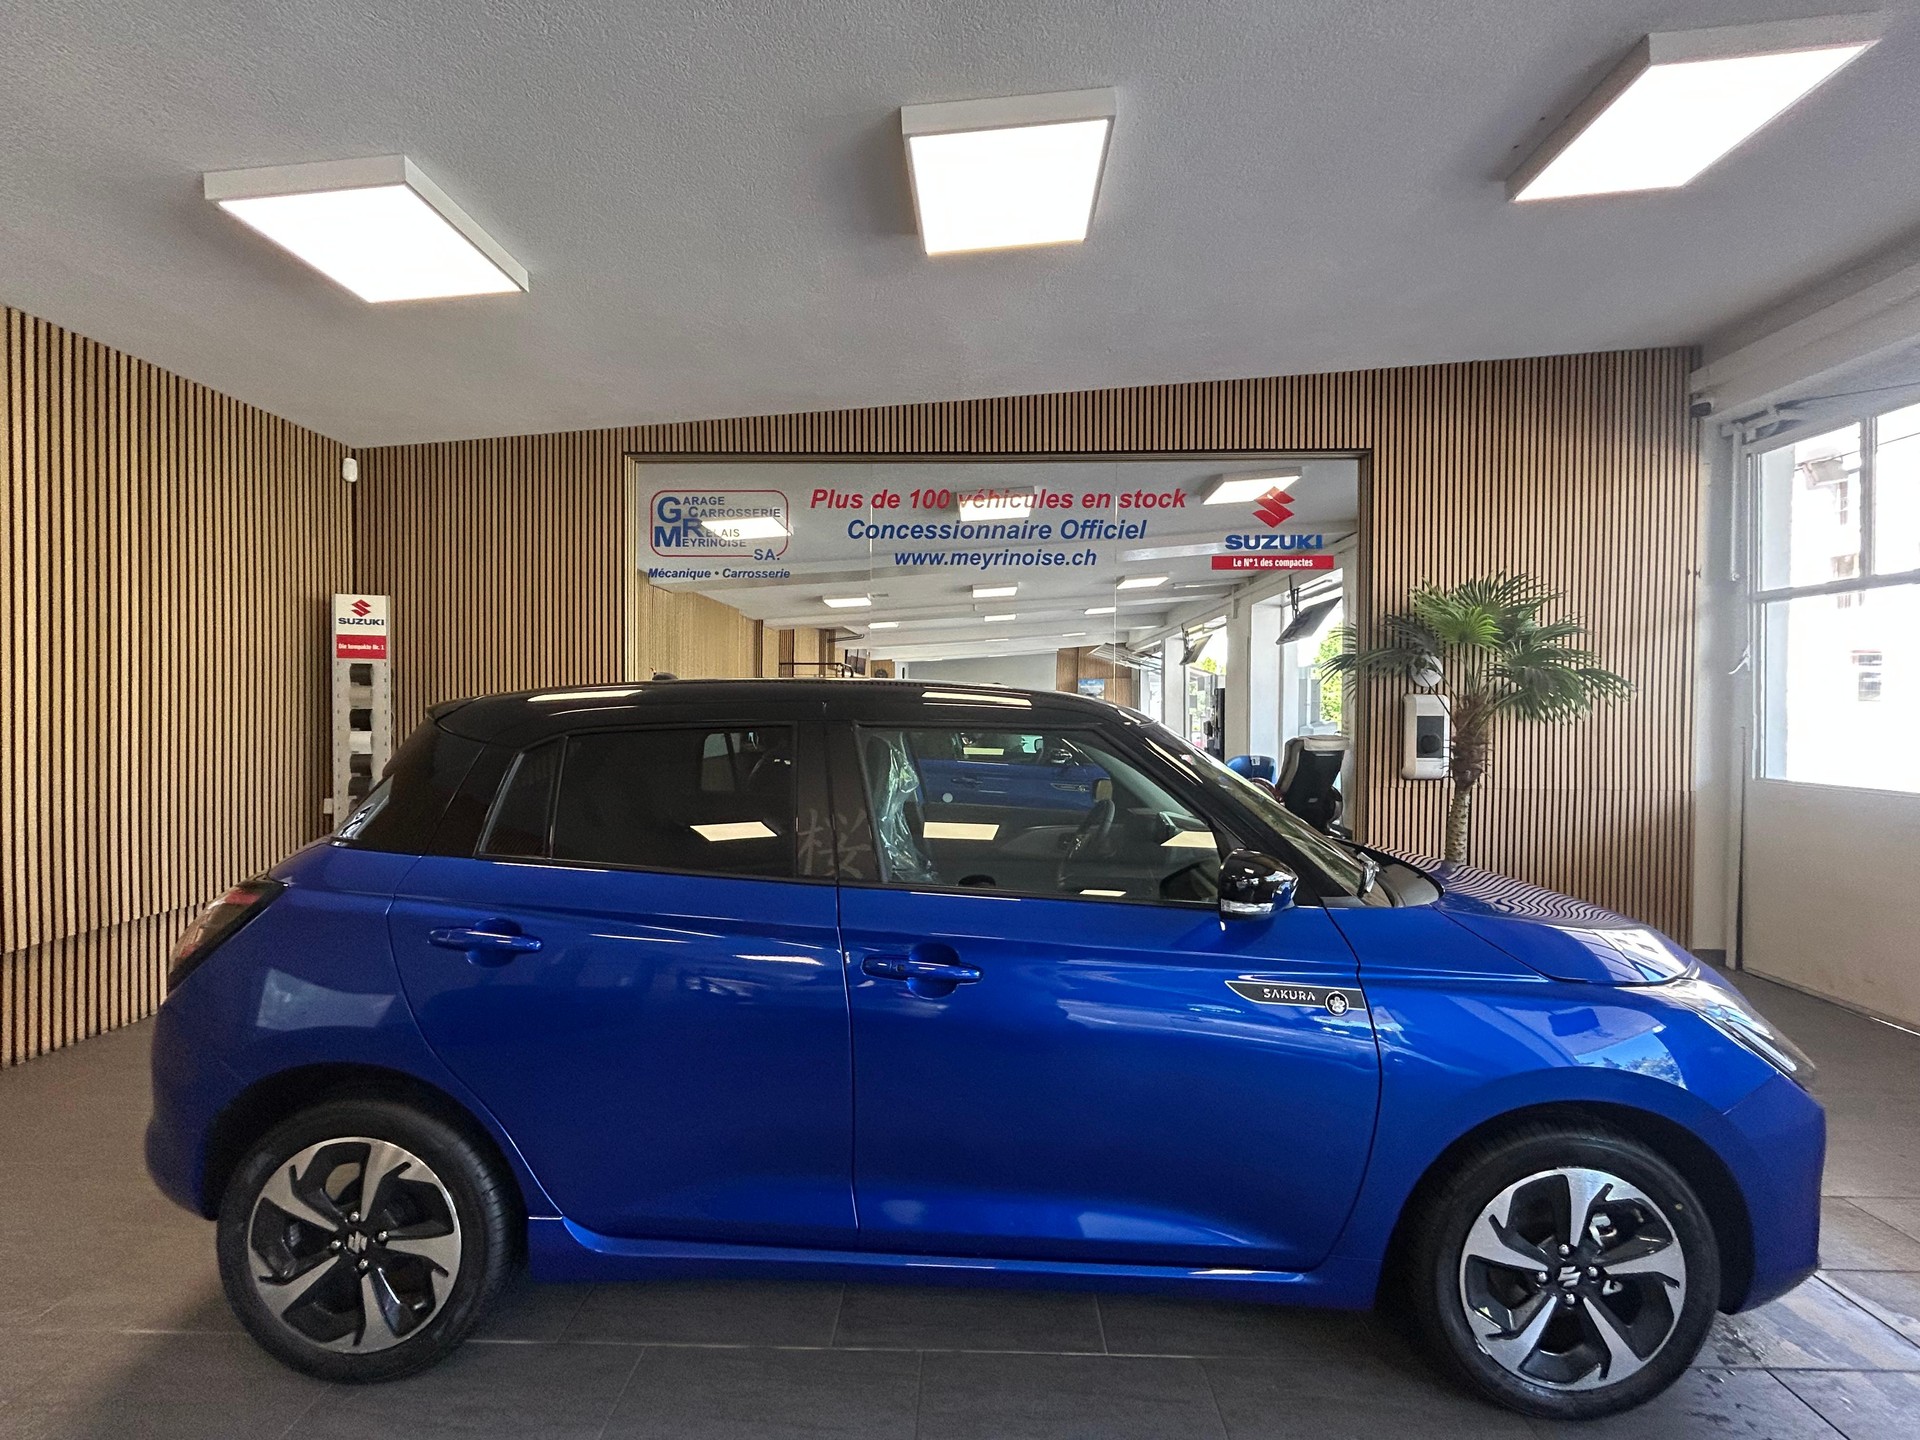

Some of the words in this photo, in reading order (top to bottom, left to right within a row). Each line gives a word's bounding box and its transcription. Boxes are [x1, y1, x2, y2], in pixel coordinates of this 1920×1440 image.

[810, 489, 864, 509] Plus
[871, 489, 901, 509] de
[909, 489, 950, 509] 100
[958, 489, 1073, 509] véhicules
[1081, 493, 1111, 509] en
[1118, 488, 1190, 509] stock
[847, 519, 1052, 540] Concessionnaire
[1060, 519, 1148, 540] Officiel
[1225, 534, 1323, 550] SUZUKI
[894, 548, 1098, 570] www.meyrinoise.ch
[1233, 558, 1242, 567] Le
[1260, 558, 1273, 567] des
[1274, 558, 1313, 569] compactes
[648, 568, 711, 581] Mécanique
[722, 568, 791, 579] Carrosserie
[338, 617, 385, 626] SUZUKI
[1263, 988, 1316, 1001] SAKURA
